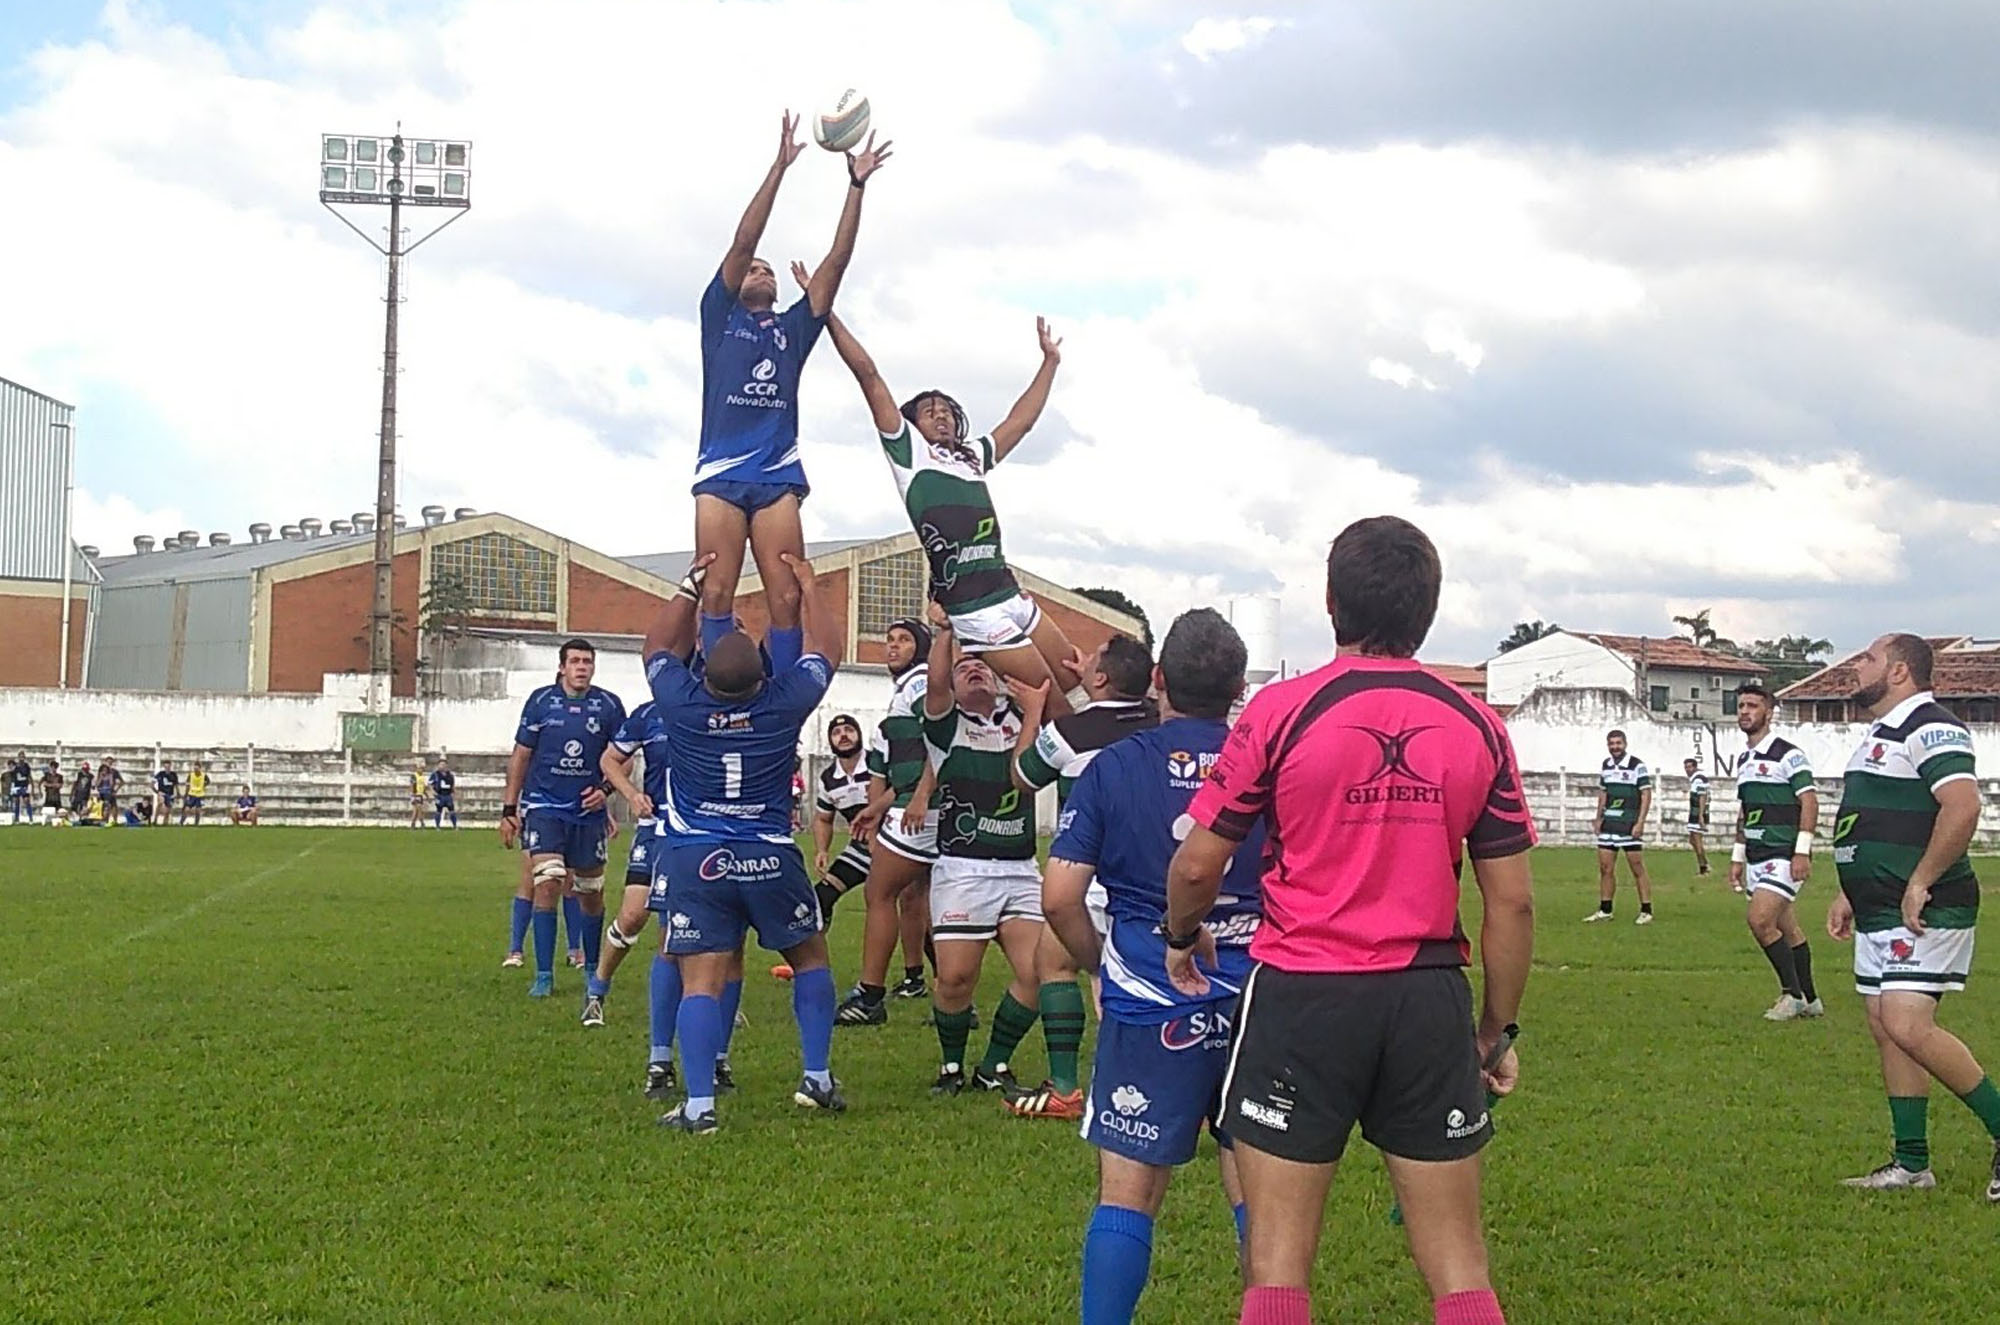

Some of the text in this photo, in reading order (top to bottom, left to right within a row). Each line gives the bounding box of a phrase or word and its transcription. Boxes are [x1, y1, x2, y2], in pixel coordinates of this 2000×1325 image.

[743, 382, 778, 396] CCR
[560, 757, 584, 768] CCR
[721, 753, 742, 798] 1
[716, 856, 780, 873] SANRAD
[1100, 1110, 1160, 1140] CLOUDS
